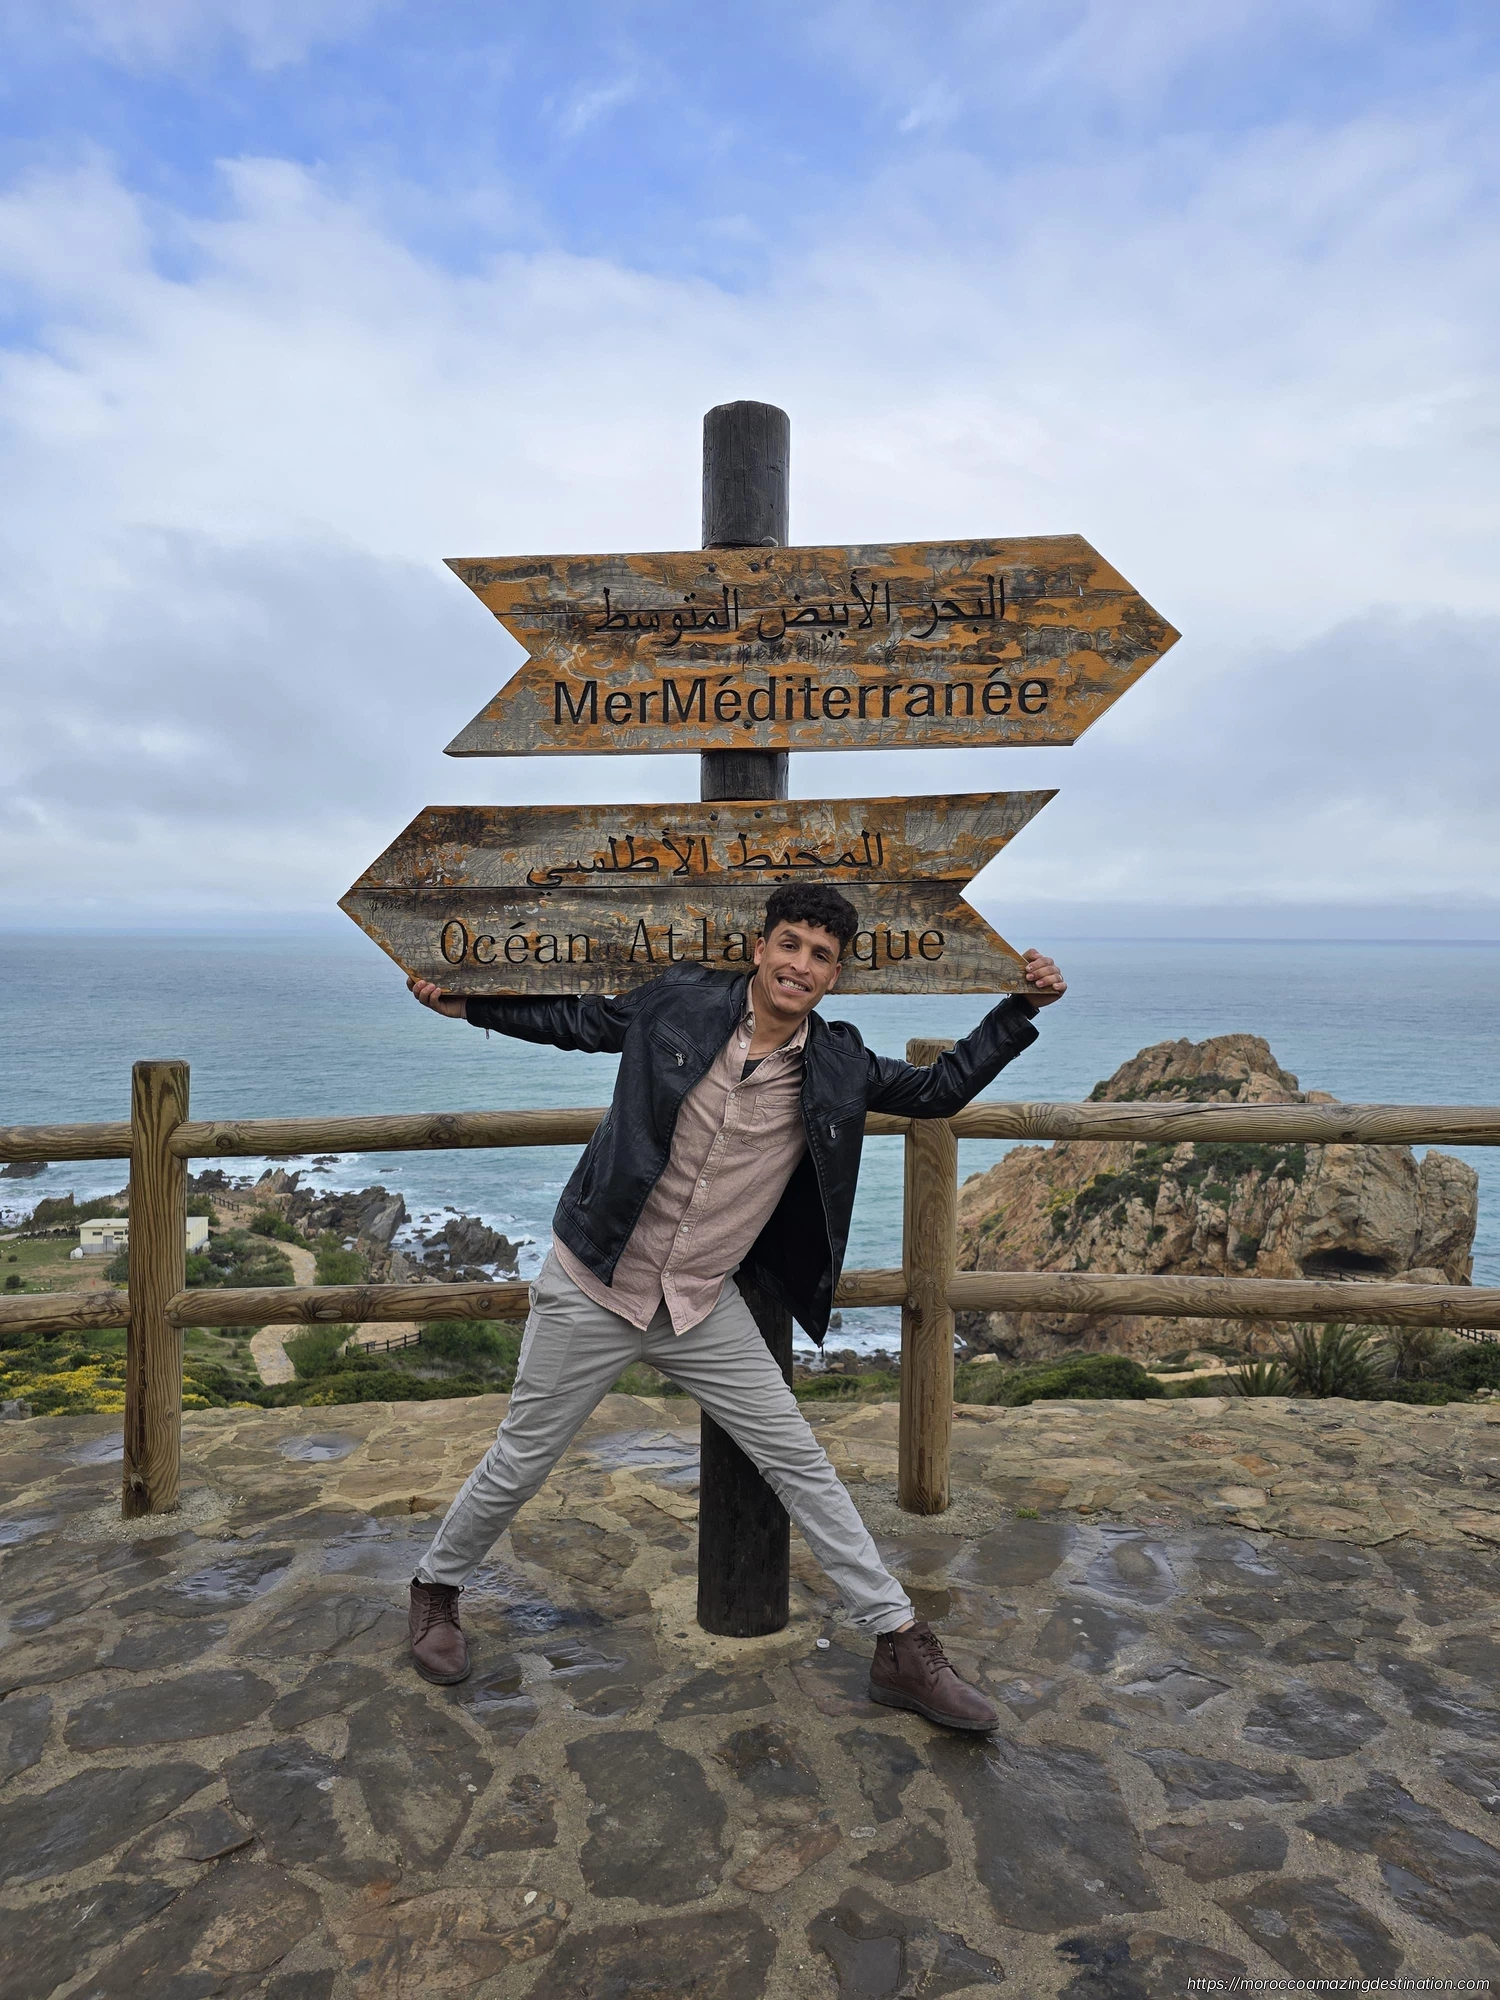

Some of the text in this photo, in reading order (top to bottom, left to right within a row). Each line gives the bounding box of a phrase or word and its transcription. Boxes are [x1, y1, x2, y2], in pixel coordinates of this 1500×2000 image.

[595, 570, 1005, 646] البحر الأبيض المتوسط
[526, 827, 883, 896] المحيط الأطلسي
[441, 917, 946, 970] Océan Atlaque
